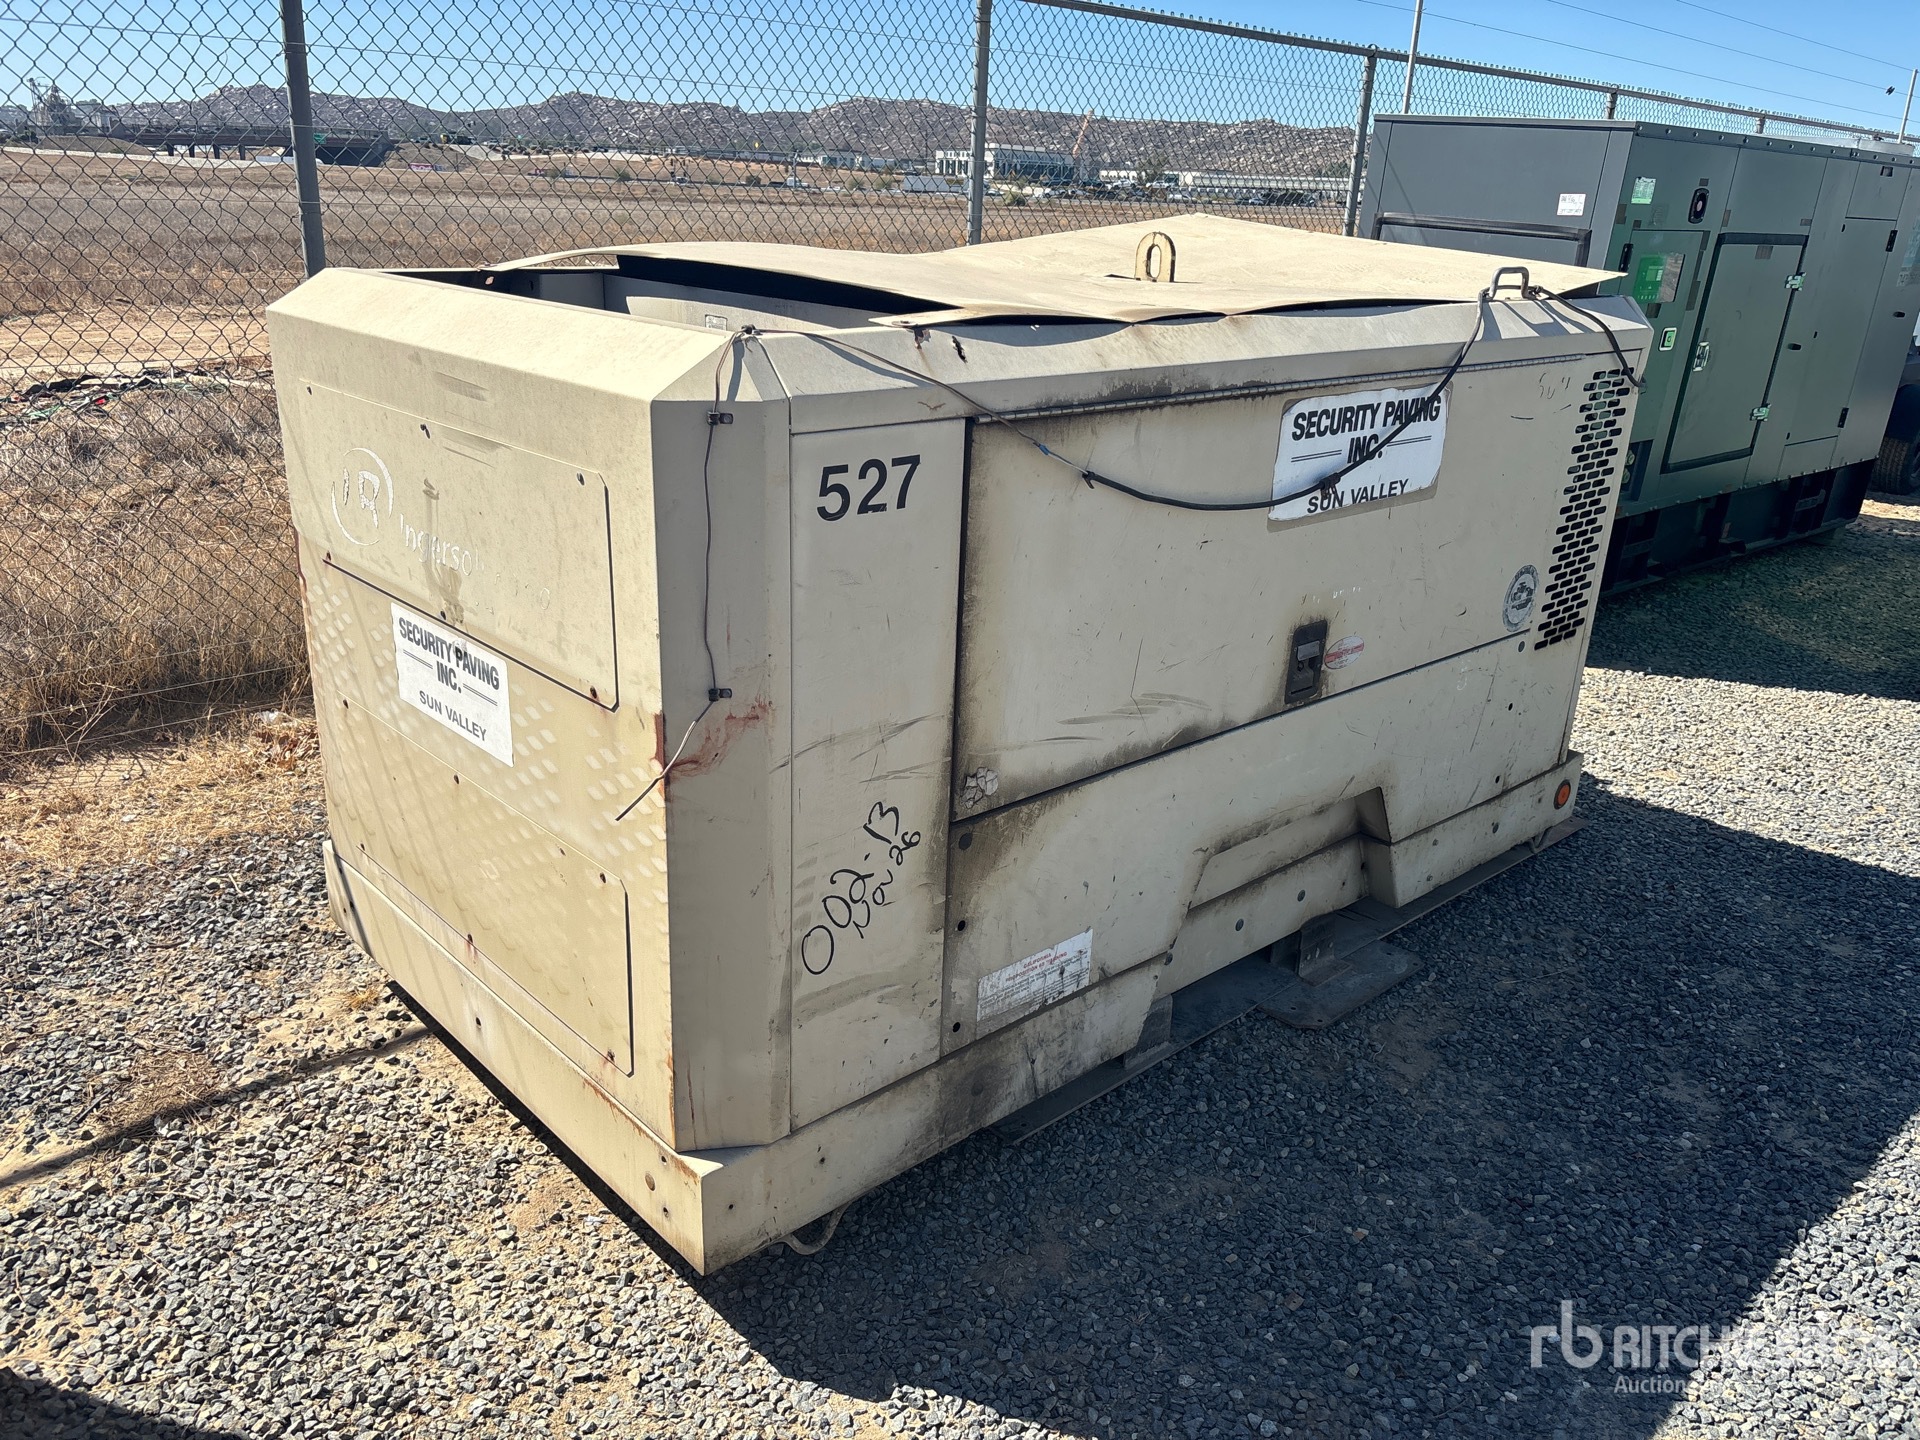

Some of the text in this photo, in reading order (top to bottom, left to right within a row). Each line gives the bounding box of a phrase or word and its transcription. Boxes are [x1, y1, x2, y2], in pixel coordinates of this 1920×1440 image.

[1291, 394, 1442, 441] SECURITY PAVING
[1347, 433, 1383, 464] INC.
[816, 454, 921, 521] 527
[1306, 478, 1409, 514] SUN VALLEY
[398, 617, 500, 691] SECURITY PAVING
[436, 660, 462, 694] INC.
[419, 690, 487, 742] SUN VALLEY
[888, 830, 922, 866] 26
